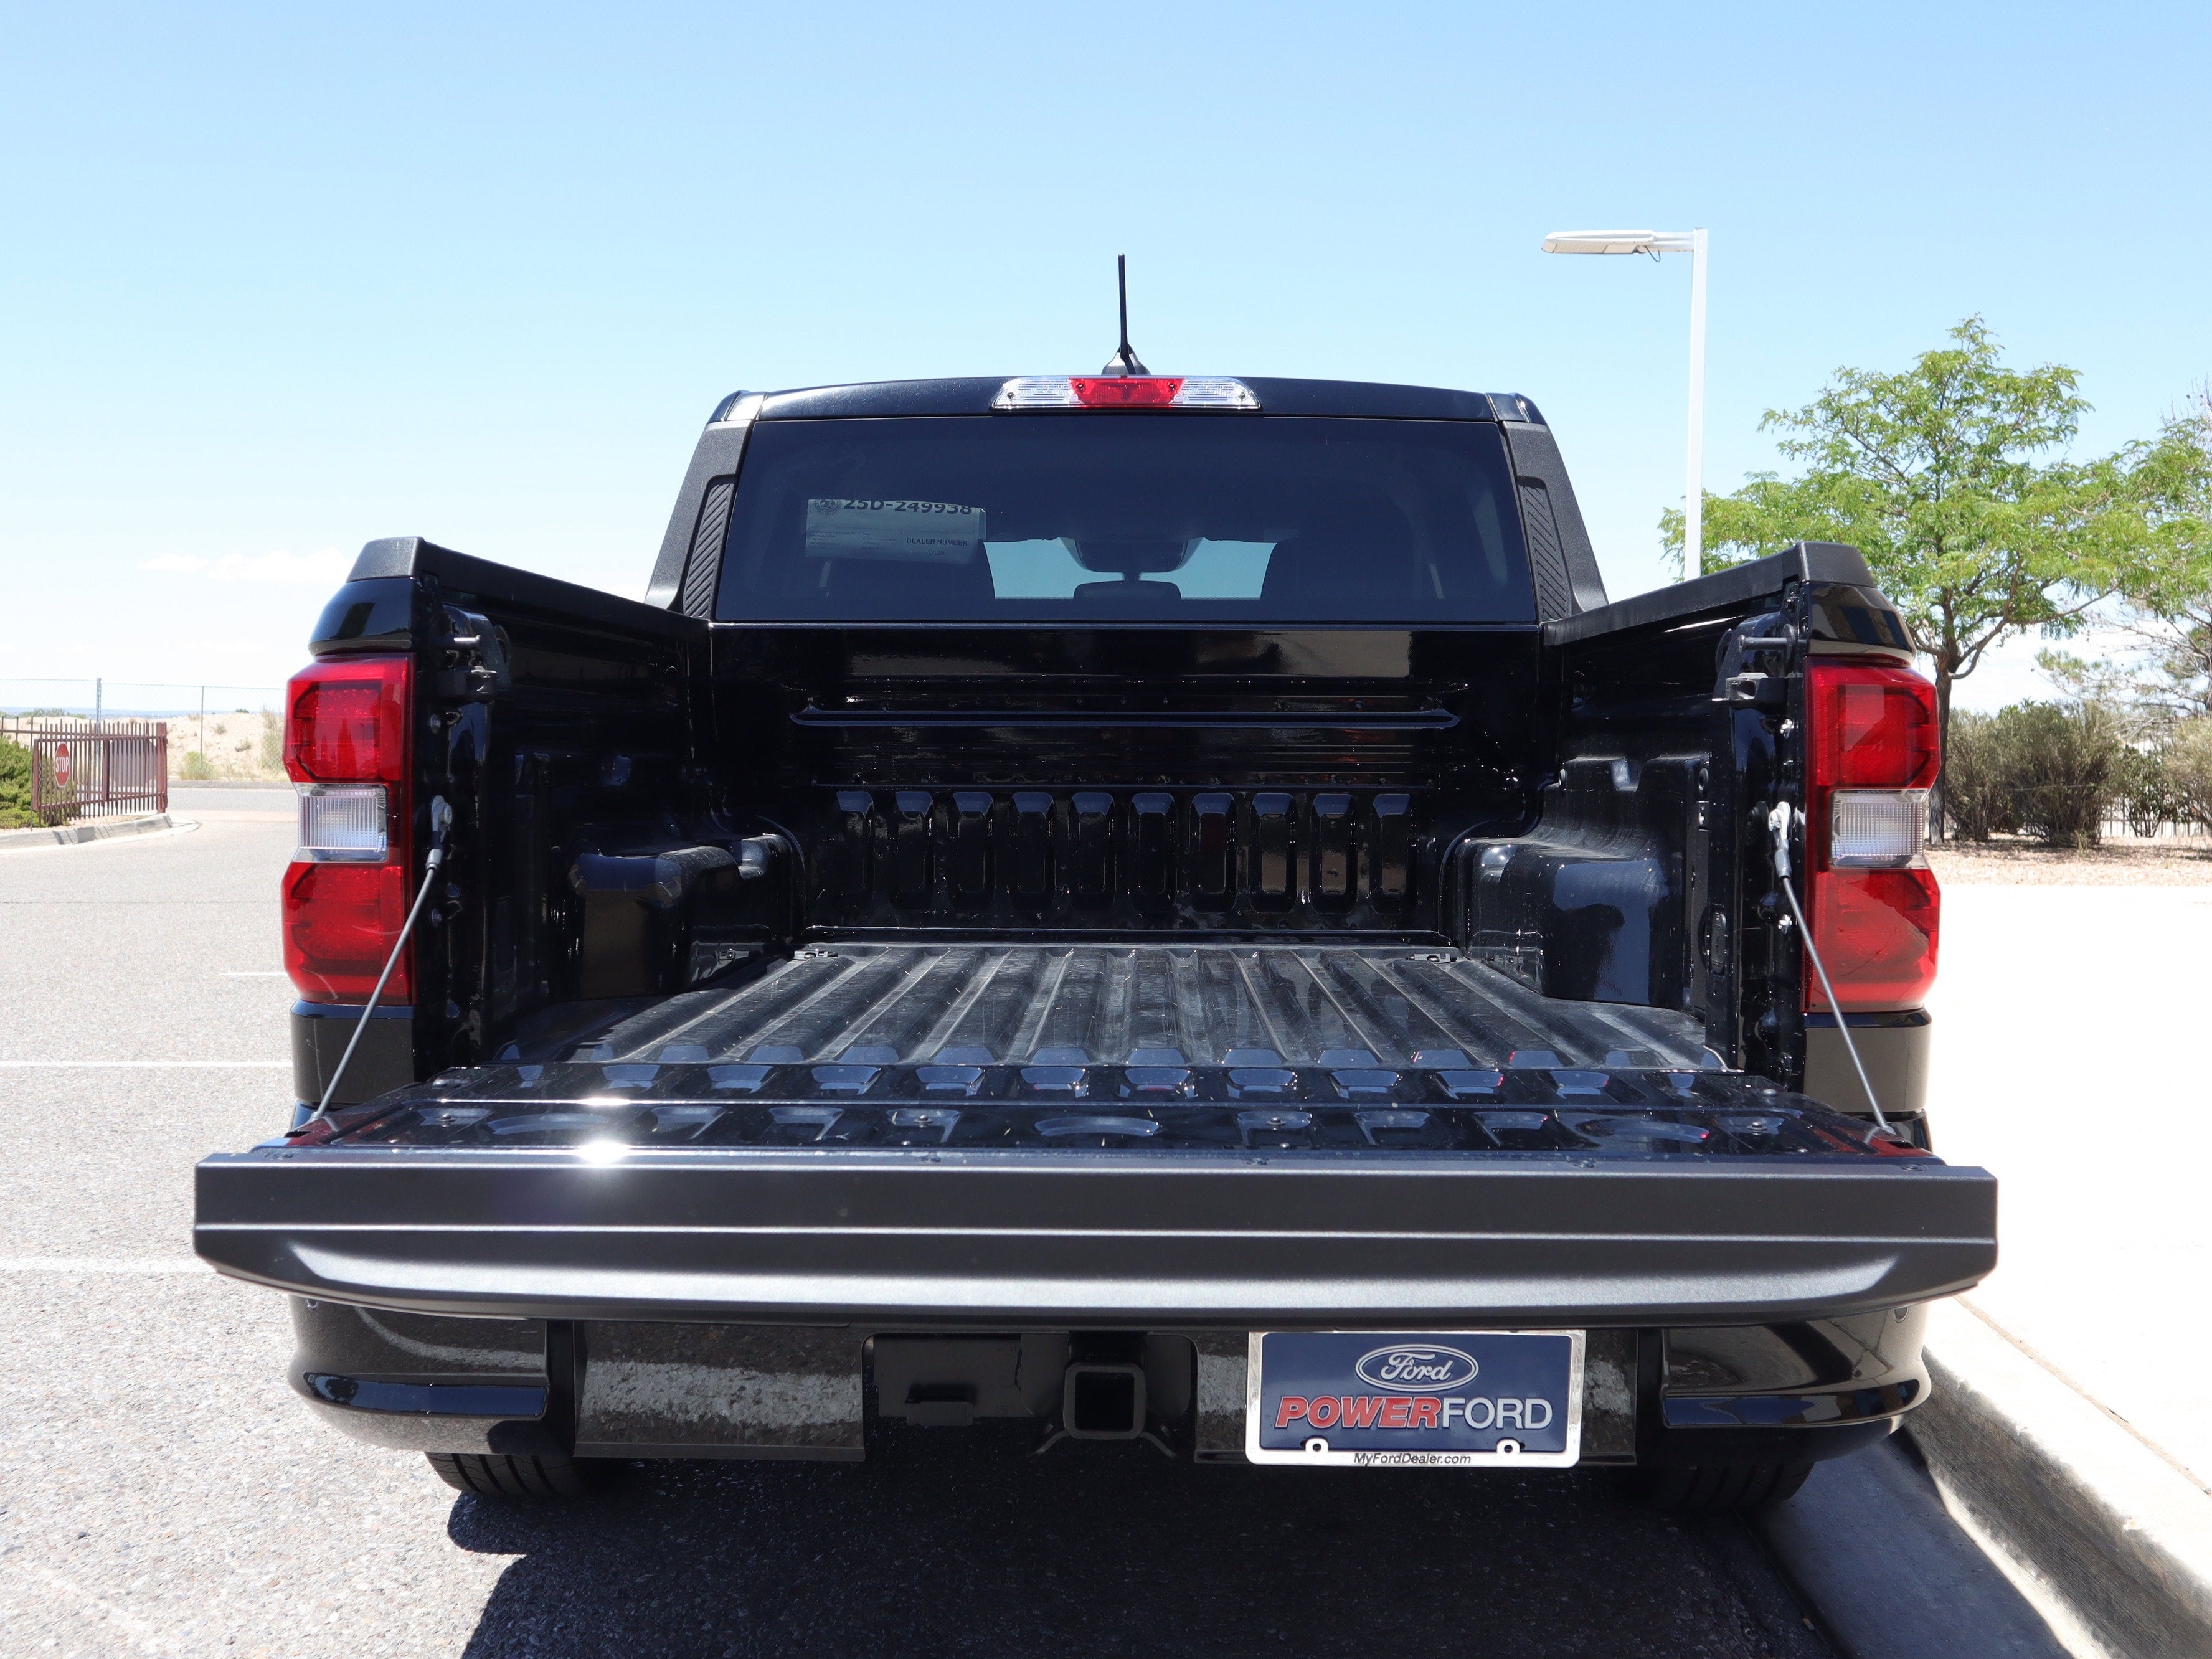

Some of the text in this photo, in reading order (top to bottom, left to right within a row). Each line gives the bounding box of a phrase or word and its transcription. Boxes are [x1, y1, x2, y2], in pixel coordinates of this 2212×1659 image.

[55, 756, 69, 773] STOP
[1381, 1351, 1453, 1381] Ford
[1354, 1453, 1471, 1465] MyFordDealer.com
